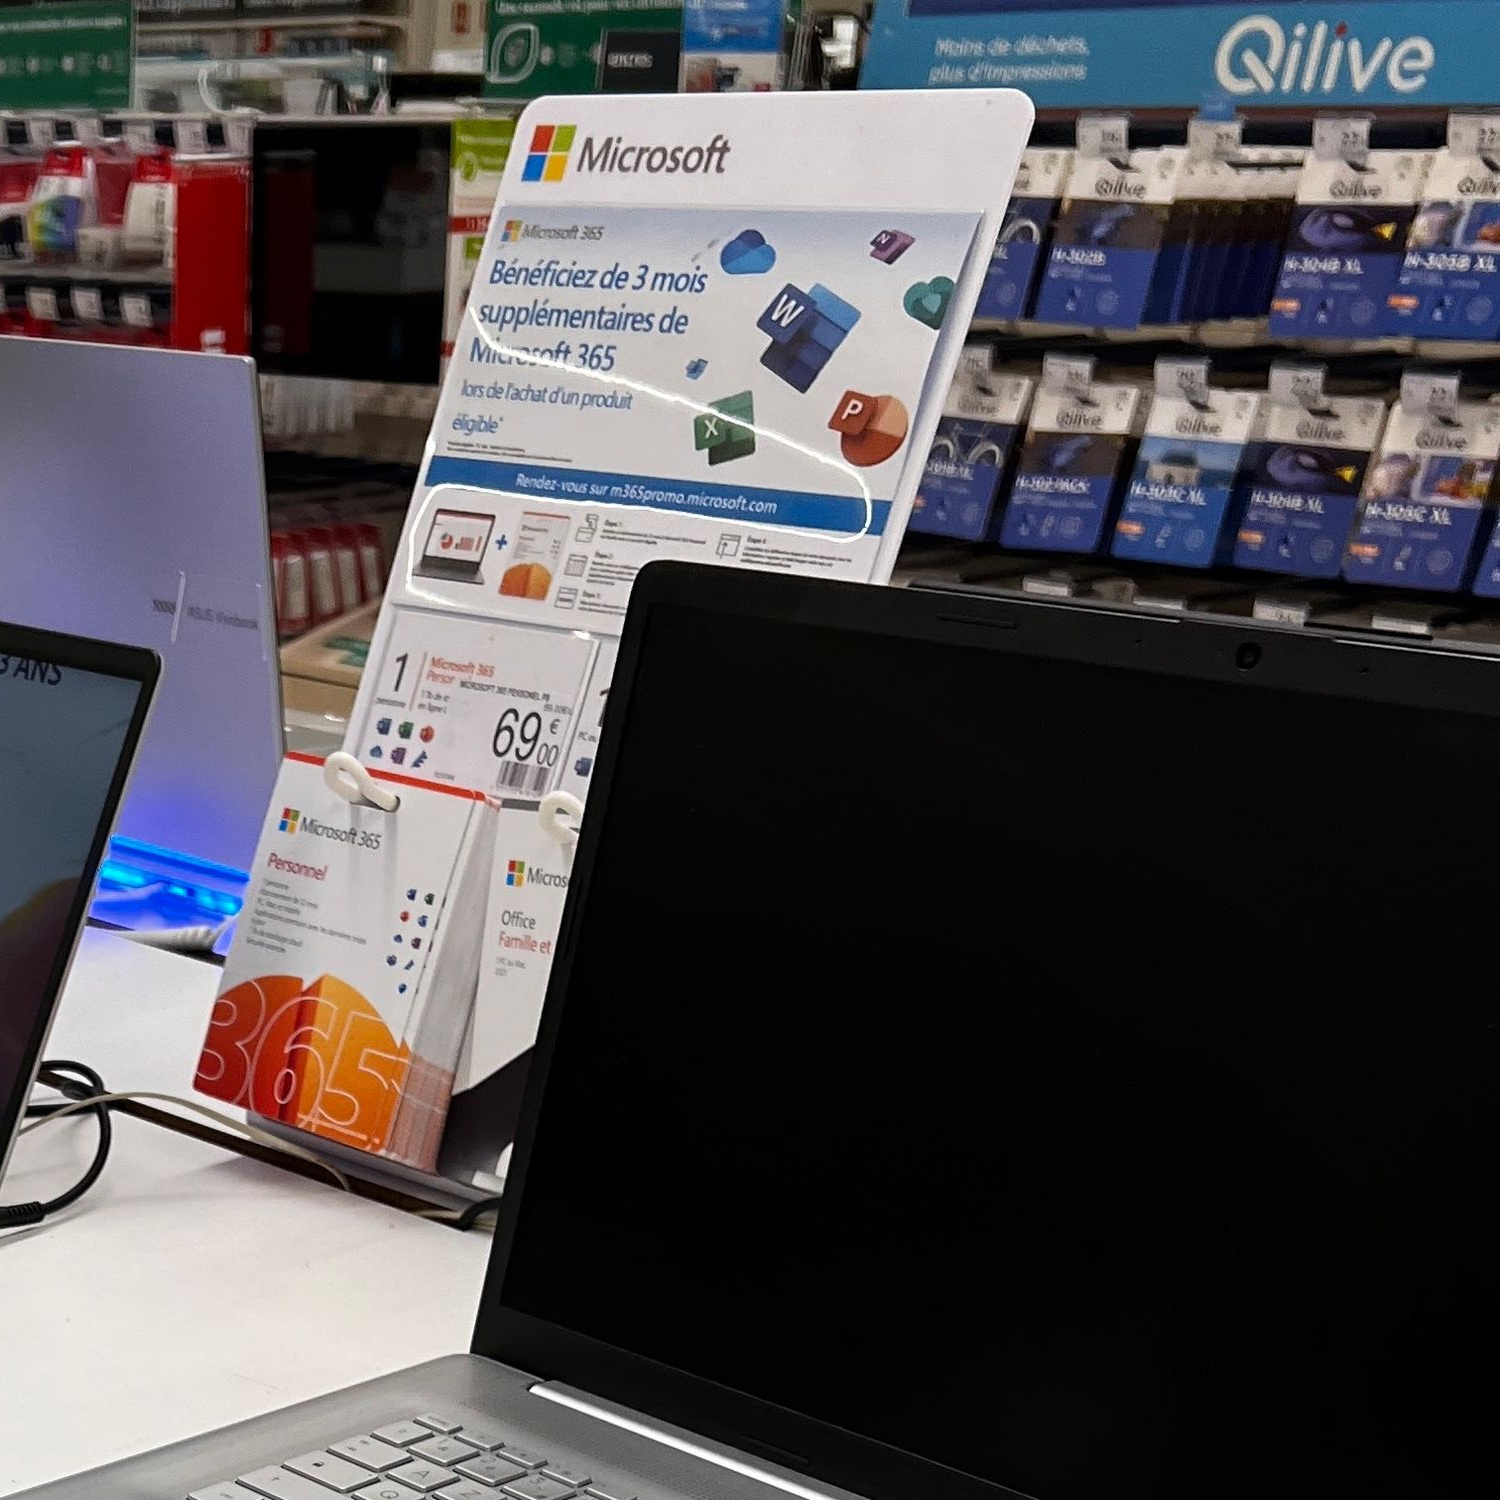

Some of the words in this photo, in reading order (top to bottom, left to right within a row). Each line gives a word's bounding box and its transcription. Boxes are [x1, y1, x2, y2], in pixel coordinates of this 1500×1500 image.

[1215, 14, 1435, 95] Qilive
[577, 134, 731, 174] Microsoft
[489, 258, 597, 289] Bénéficiez
[600, 262, 628, 290] de
[632, 264, 648, 290] 3
[650, 266, 708, 294] mois
[478, 298, 657, 334] supplémentaires
[659, 307, 689, 335] de
[469, 336, 571, 367] Microsoft
[576, 344, 617, 372] 365
[516, 473, 587, 496] Rendez-vous
[590, 480, 607, 496] sur
[610, 484, 779, 514] m365promo.microsoft.com
[8, 657, 63, 687] ANS
[394, 653, 408, 692] 1
[430, 656, 476, 675] Microsoft
[492, 708, 542, 761] 69
[549, 718, 560, 735] €
[536, 743, 559, 767] 00
[301, 816, 358, 844] Microsoft
[357, 830, 381, 850] 365
[267, 852, 329, 882] Personnel
[500, 909, 536, 931] Office
[499, 930, 538, 954] Famille
[539, 938, 552, 955] et
